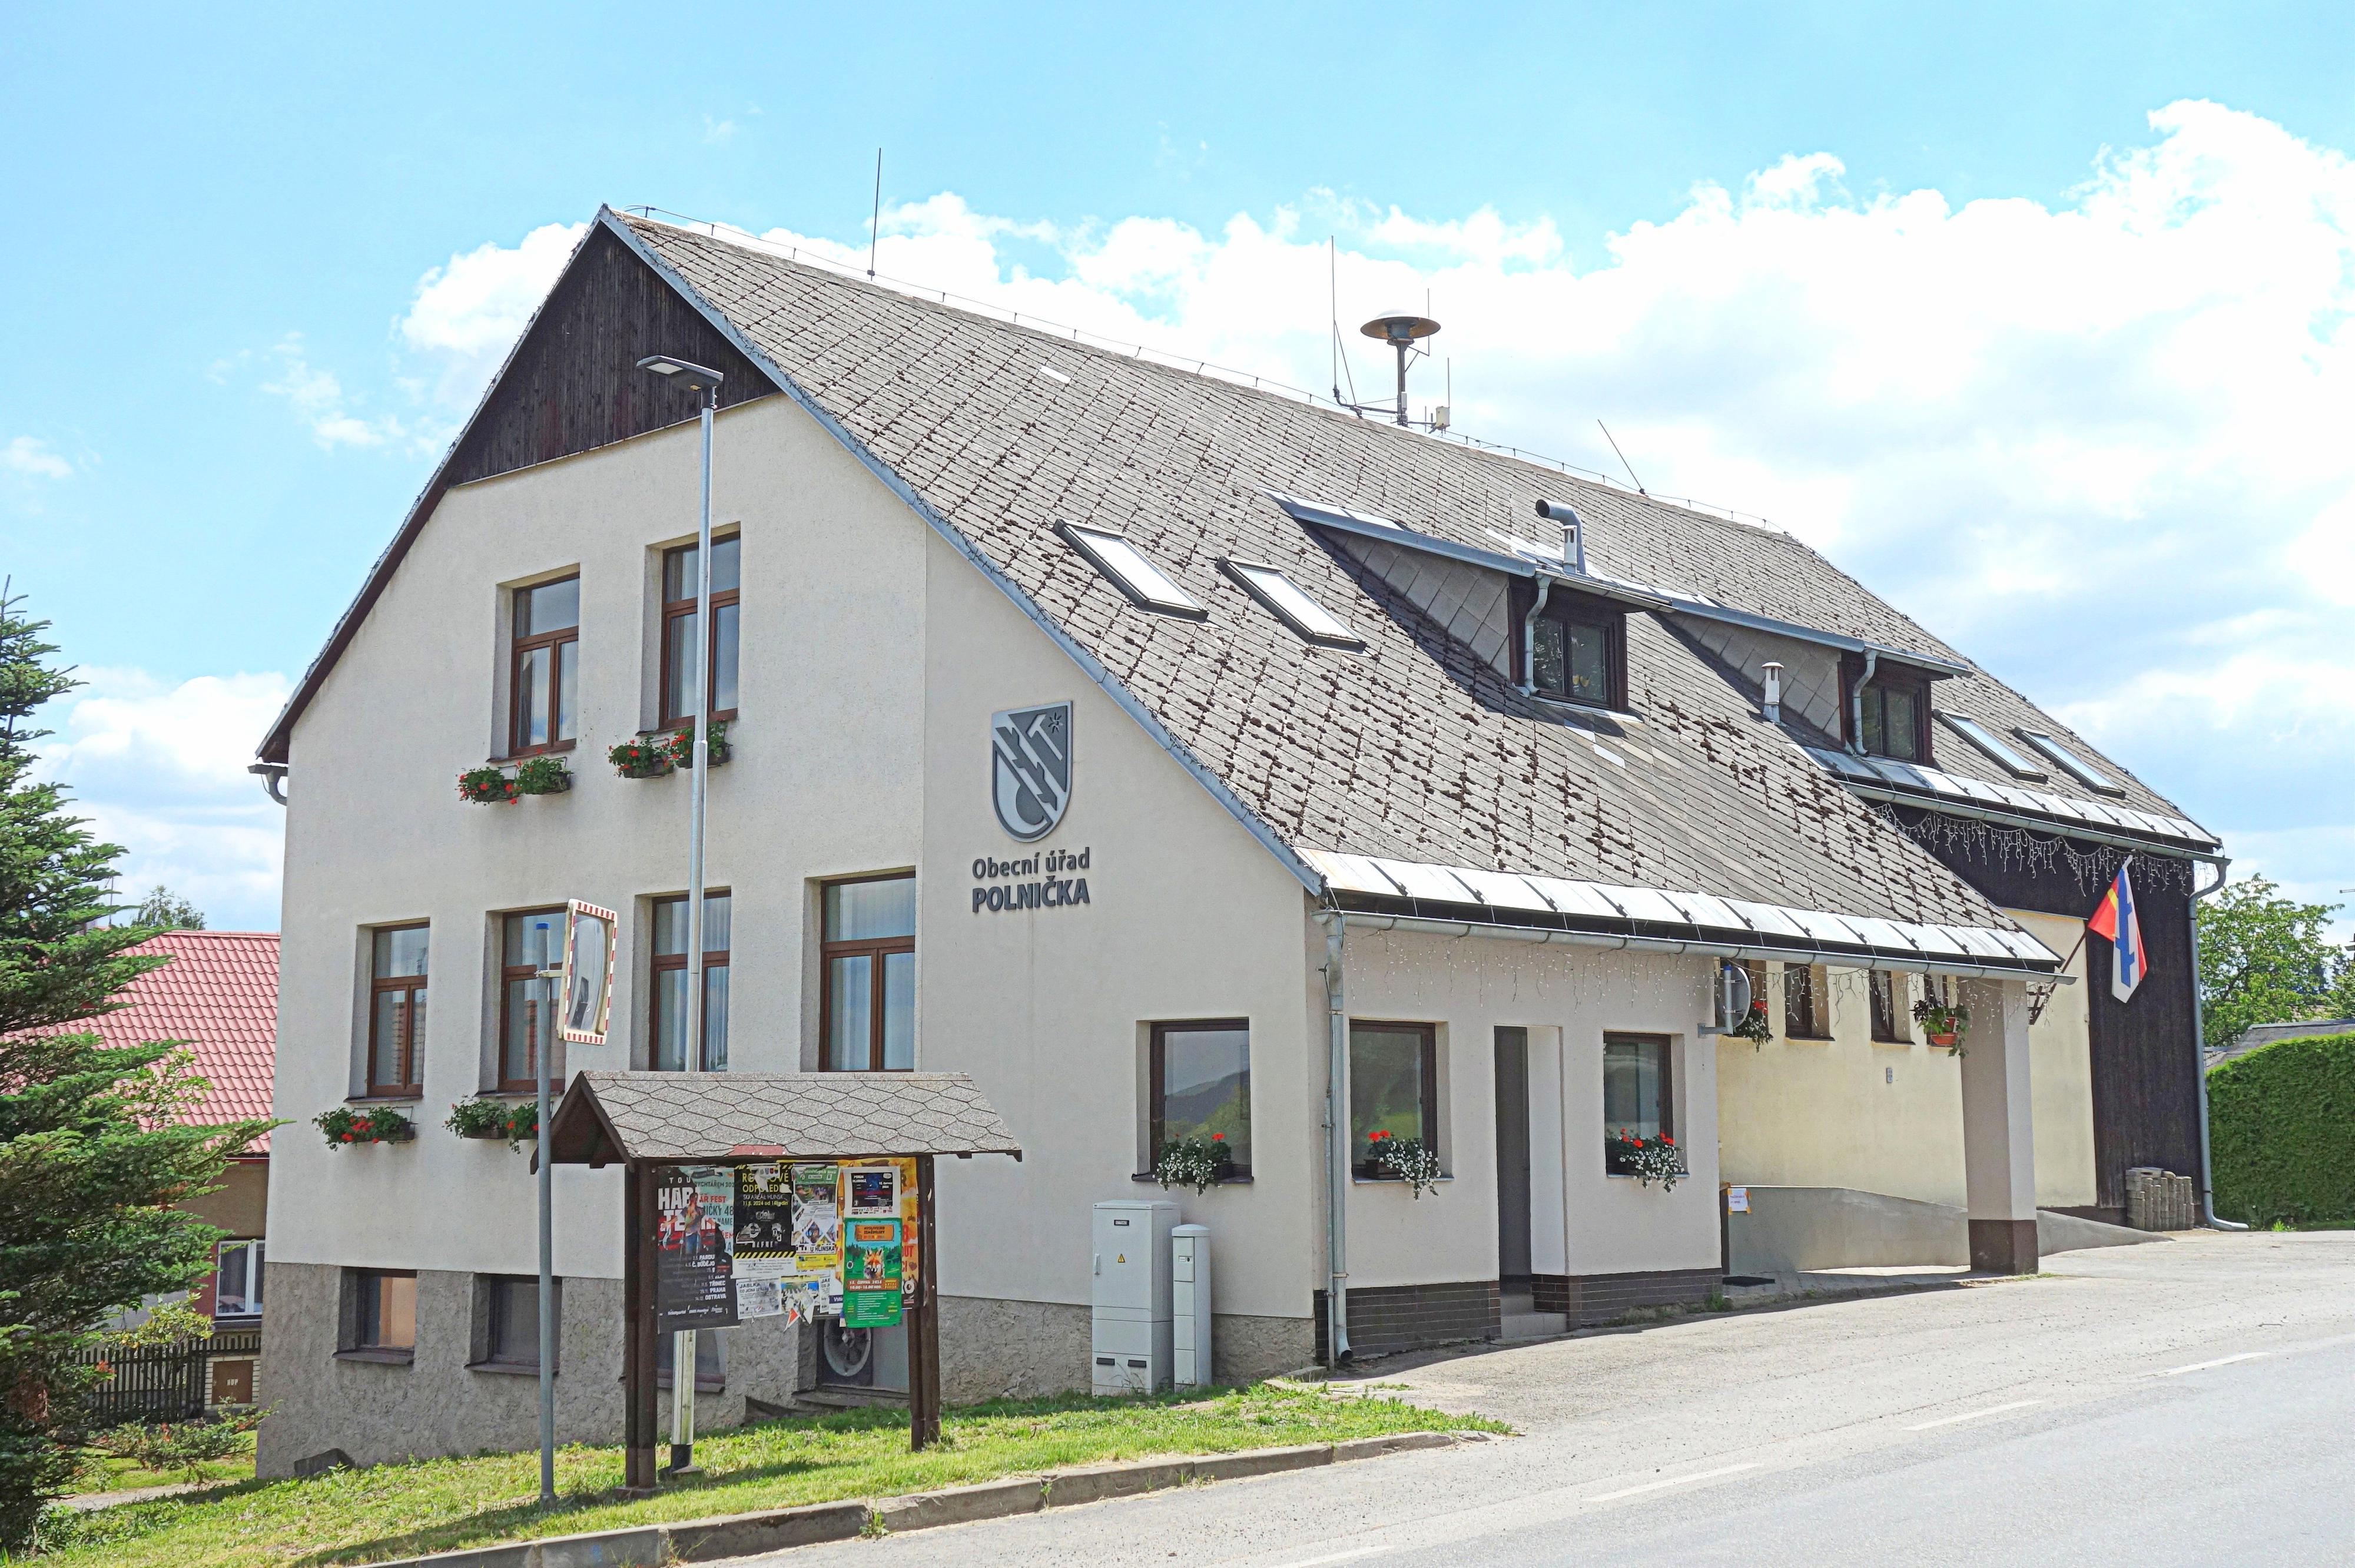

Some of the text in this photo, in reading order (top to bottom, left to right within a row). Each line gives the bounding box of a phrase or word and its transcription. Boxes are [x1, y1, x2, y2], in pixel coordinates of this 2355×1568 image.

[972, 847, 1090, 879] Obecní úřad
[972, 875, 1090, 913] POLNIČKA
